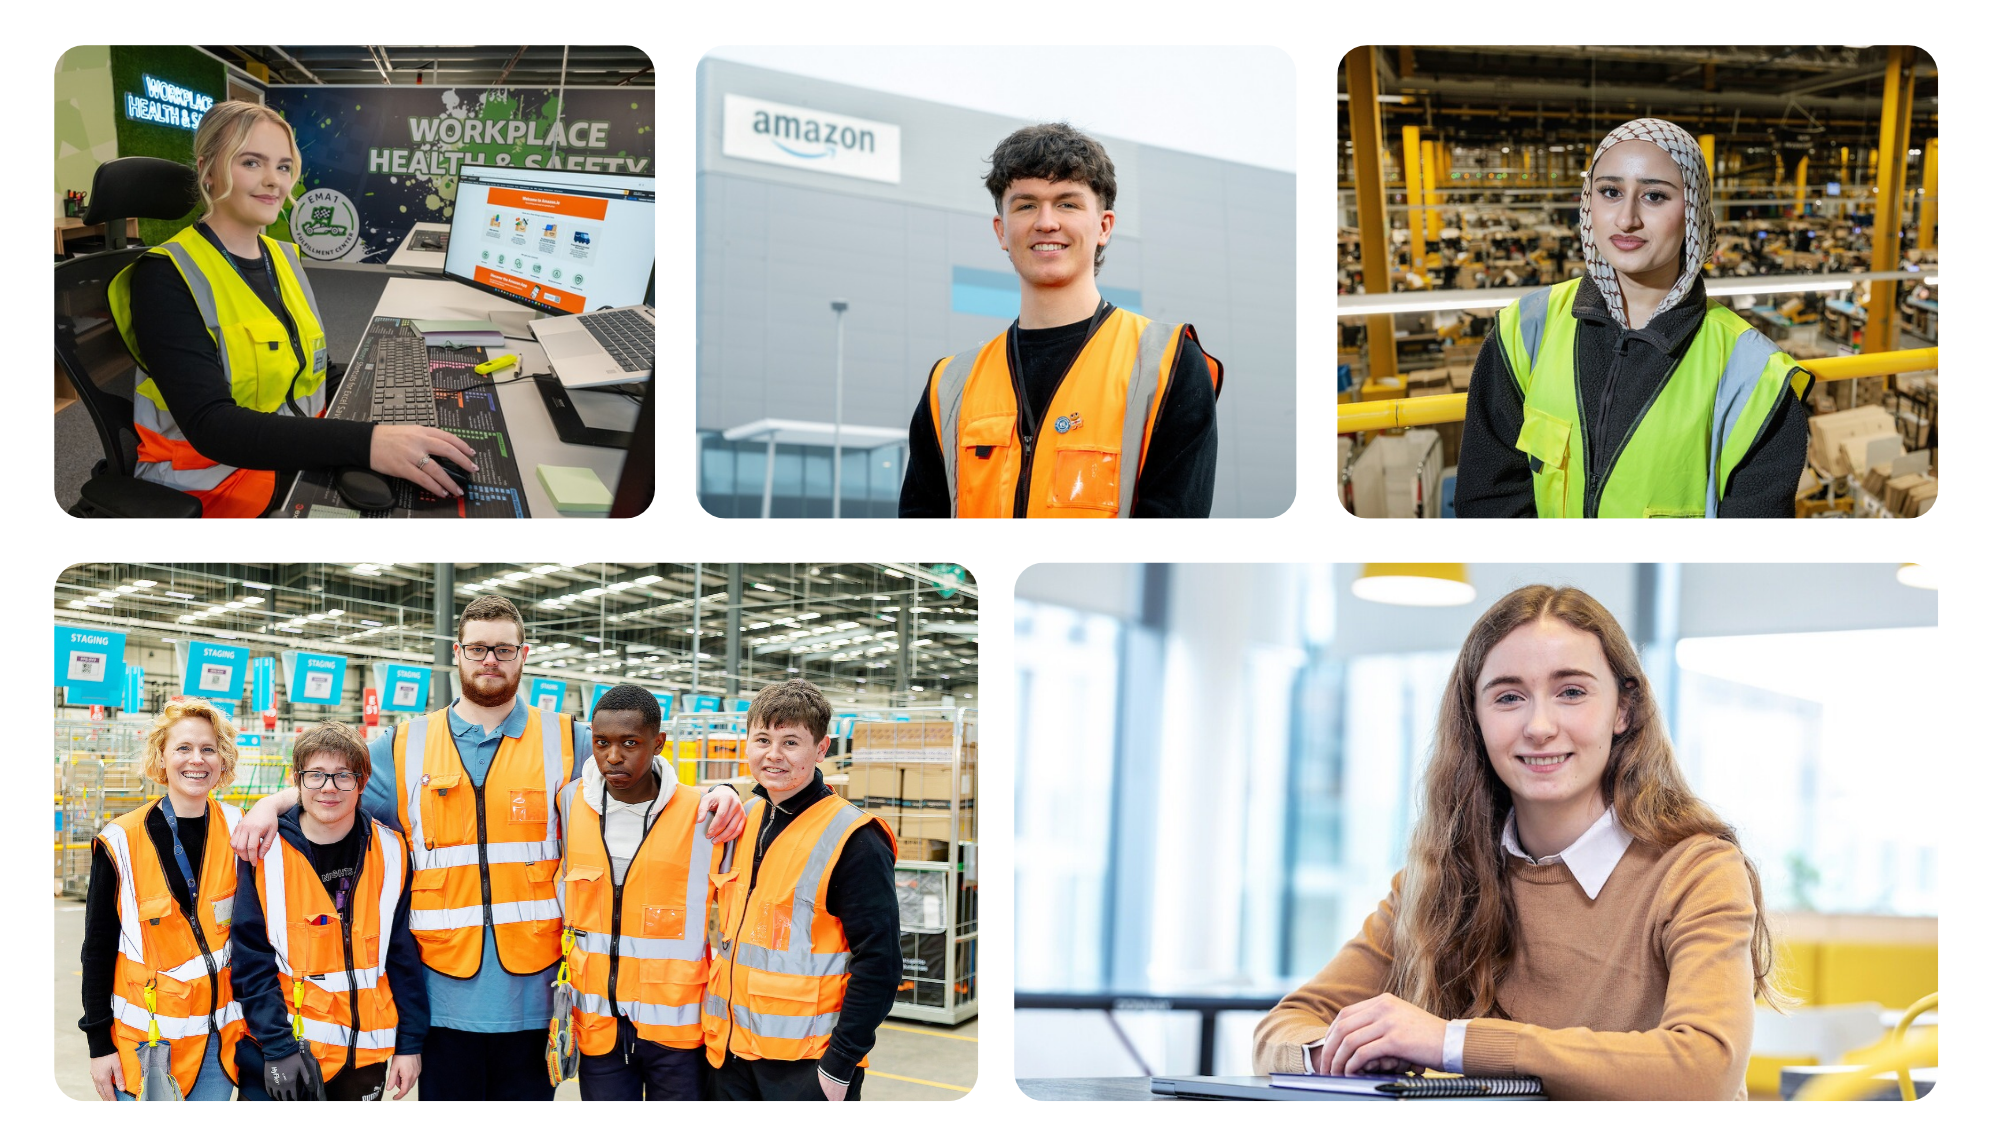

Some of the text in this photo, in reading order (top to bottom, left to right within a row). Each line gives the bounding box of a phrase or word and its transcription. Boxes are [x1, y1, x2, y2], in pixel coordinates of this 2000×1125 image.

[145, 76, 214, 112] WORKPLACE
[128, 95, 180, 126] HEALTH
[181, 109, 191, 128] &
[408, 117, 610, 149] WORKPLACE
[753, 110, 876, 153] amazon
[368, 149, 486, 175] HEALTH
[296, 232, 354, 256] FULFILLMENT CENTER
[339, 390, 352, 405] Excel
[70, 633, 109, 646] STAGING
[203, 648, 235, 659] STAGING
[307, 658, 336, 669] STAGING
[396, 669, 422, 679] STAGING
